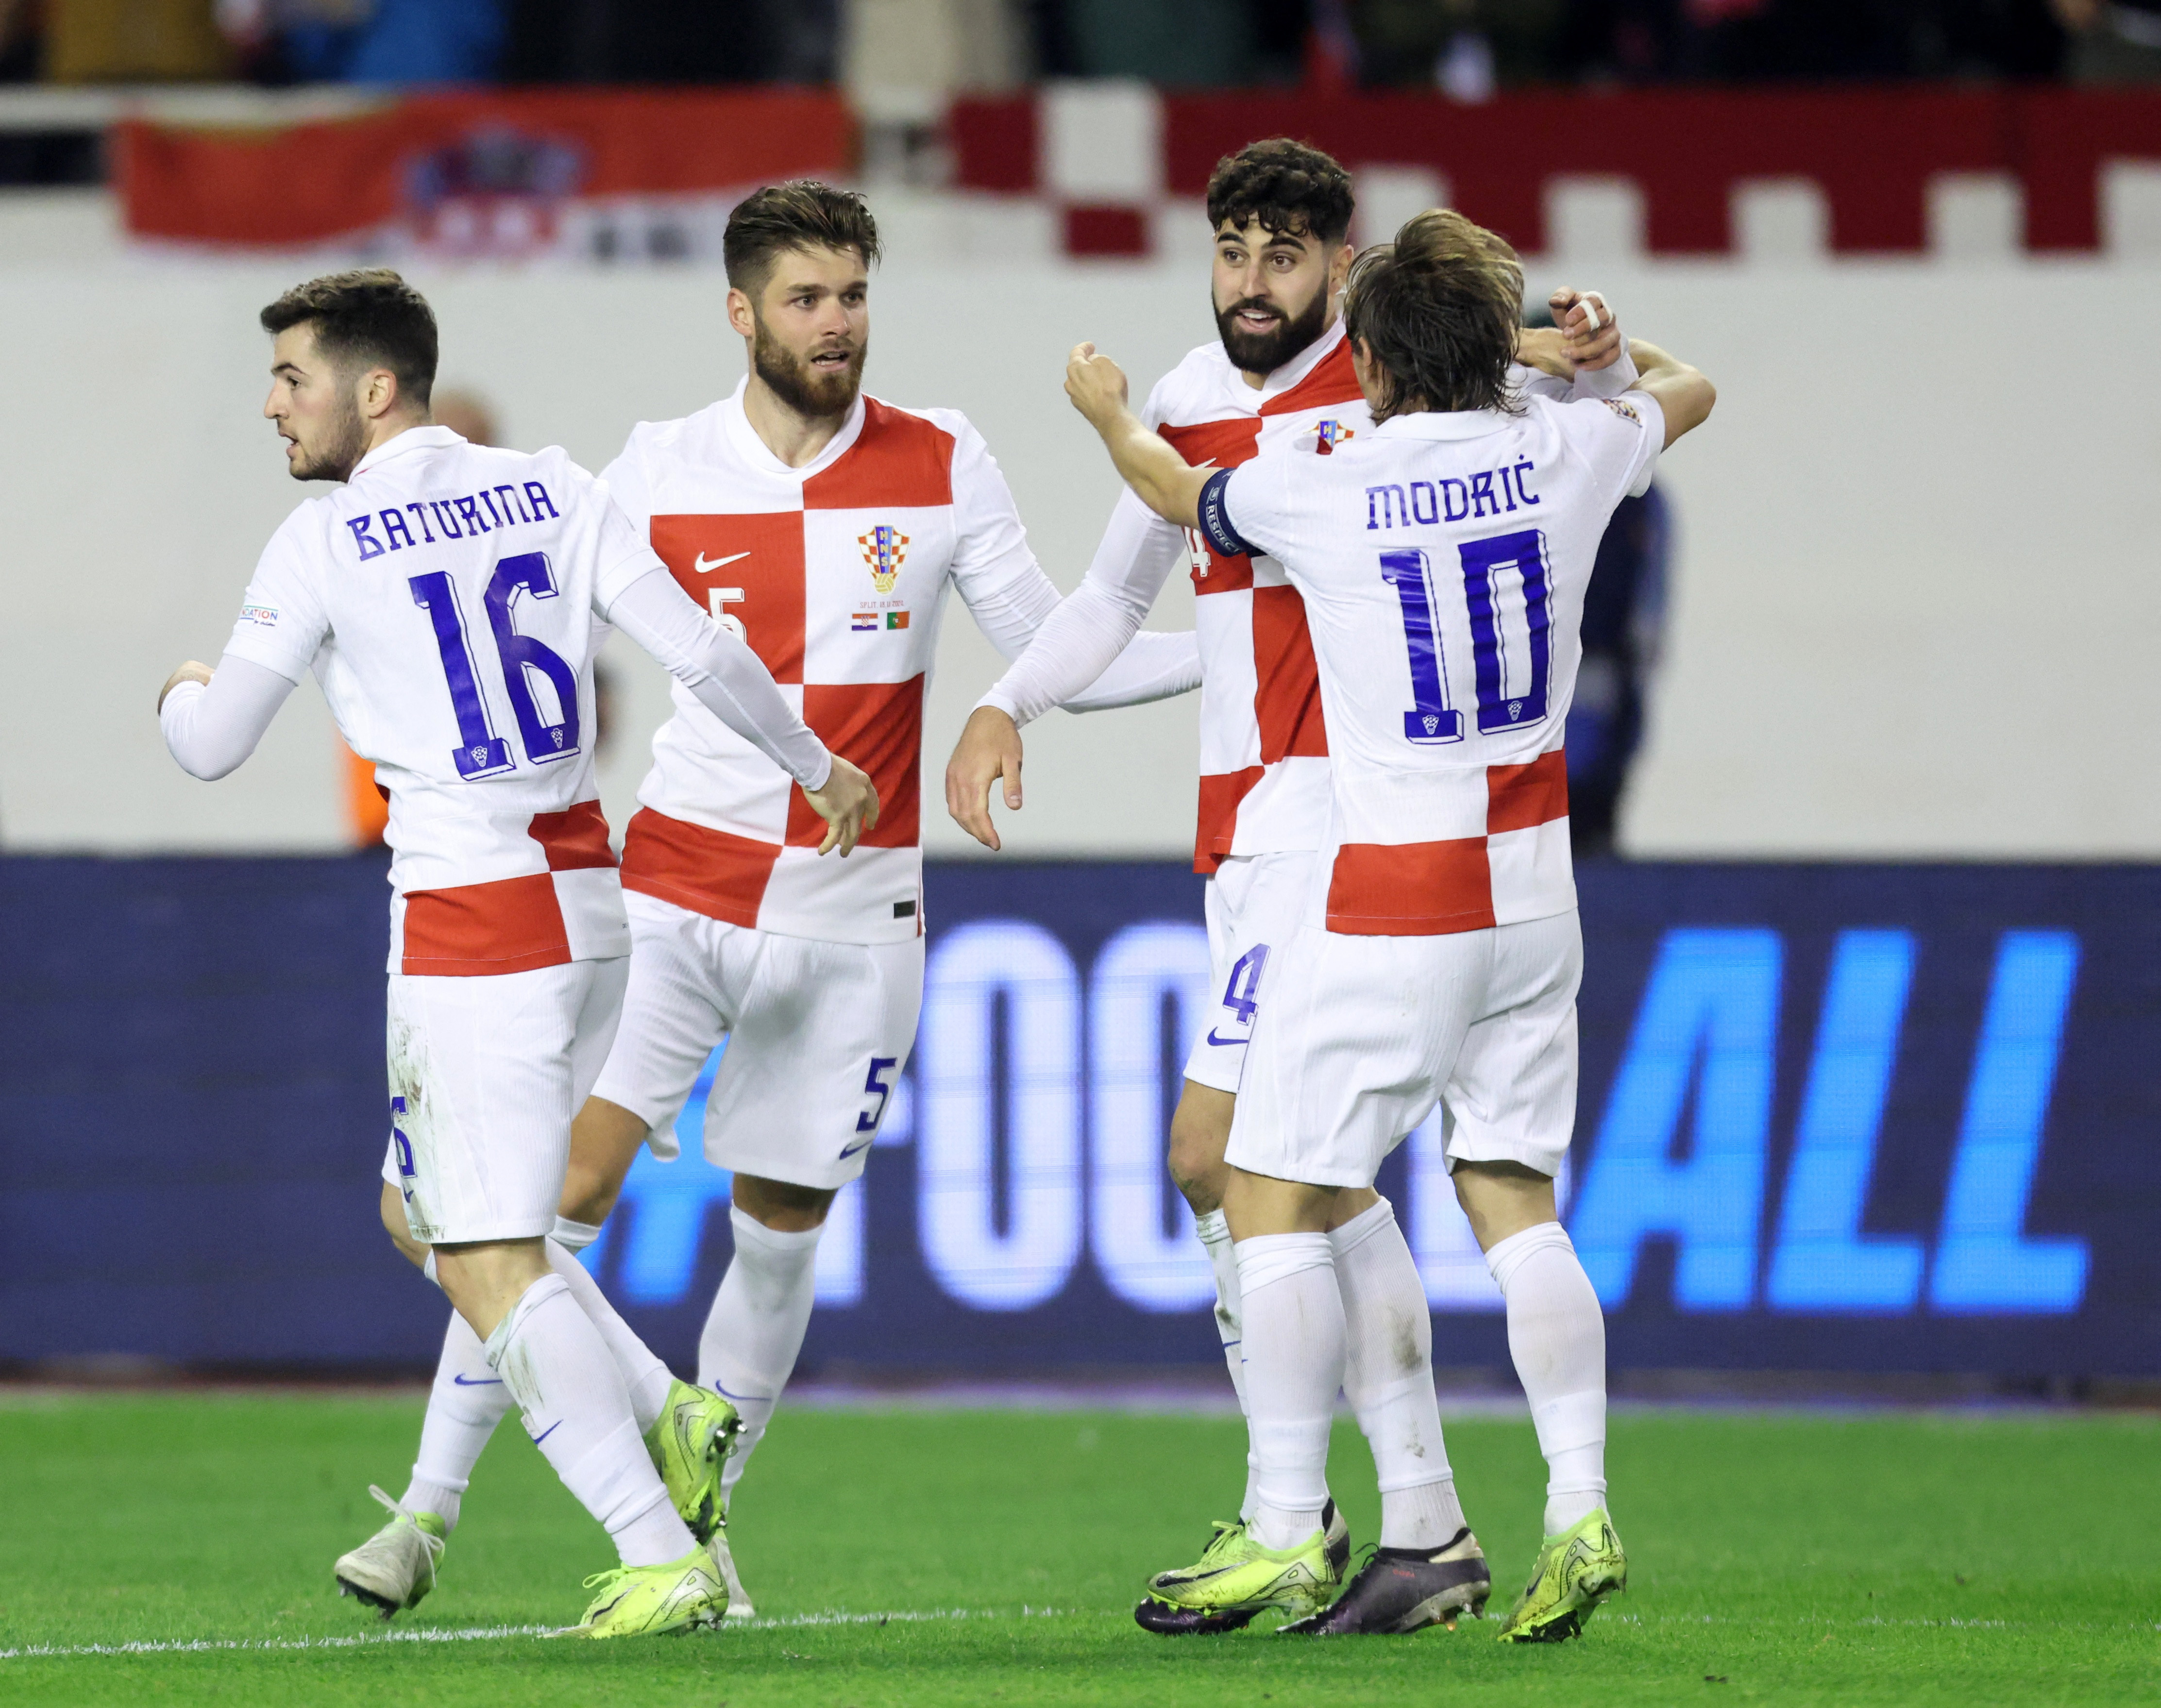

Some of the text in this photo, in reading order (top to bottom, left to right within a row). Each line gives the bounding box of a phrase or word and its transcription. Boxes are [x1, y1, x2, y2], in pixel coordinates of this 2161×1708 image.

[346, 481, 560, 561] BATURINA
[880, 531, 889, 567] HNS
[708, 587, 747, 645] 5
[1379, 528, 1554, 744] 10
[408, 552, 581, 781] 16
[1222, 943, 1271, 1026] 4
[856, 1057, 897, 1134] 5
